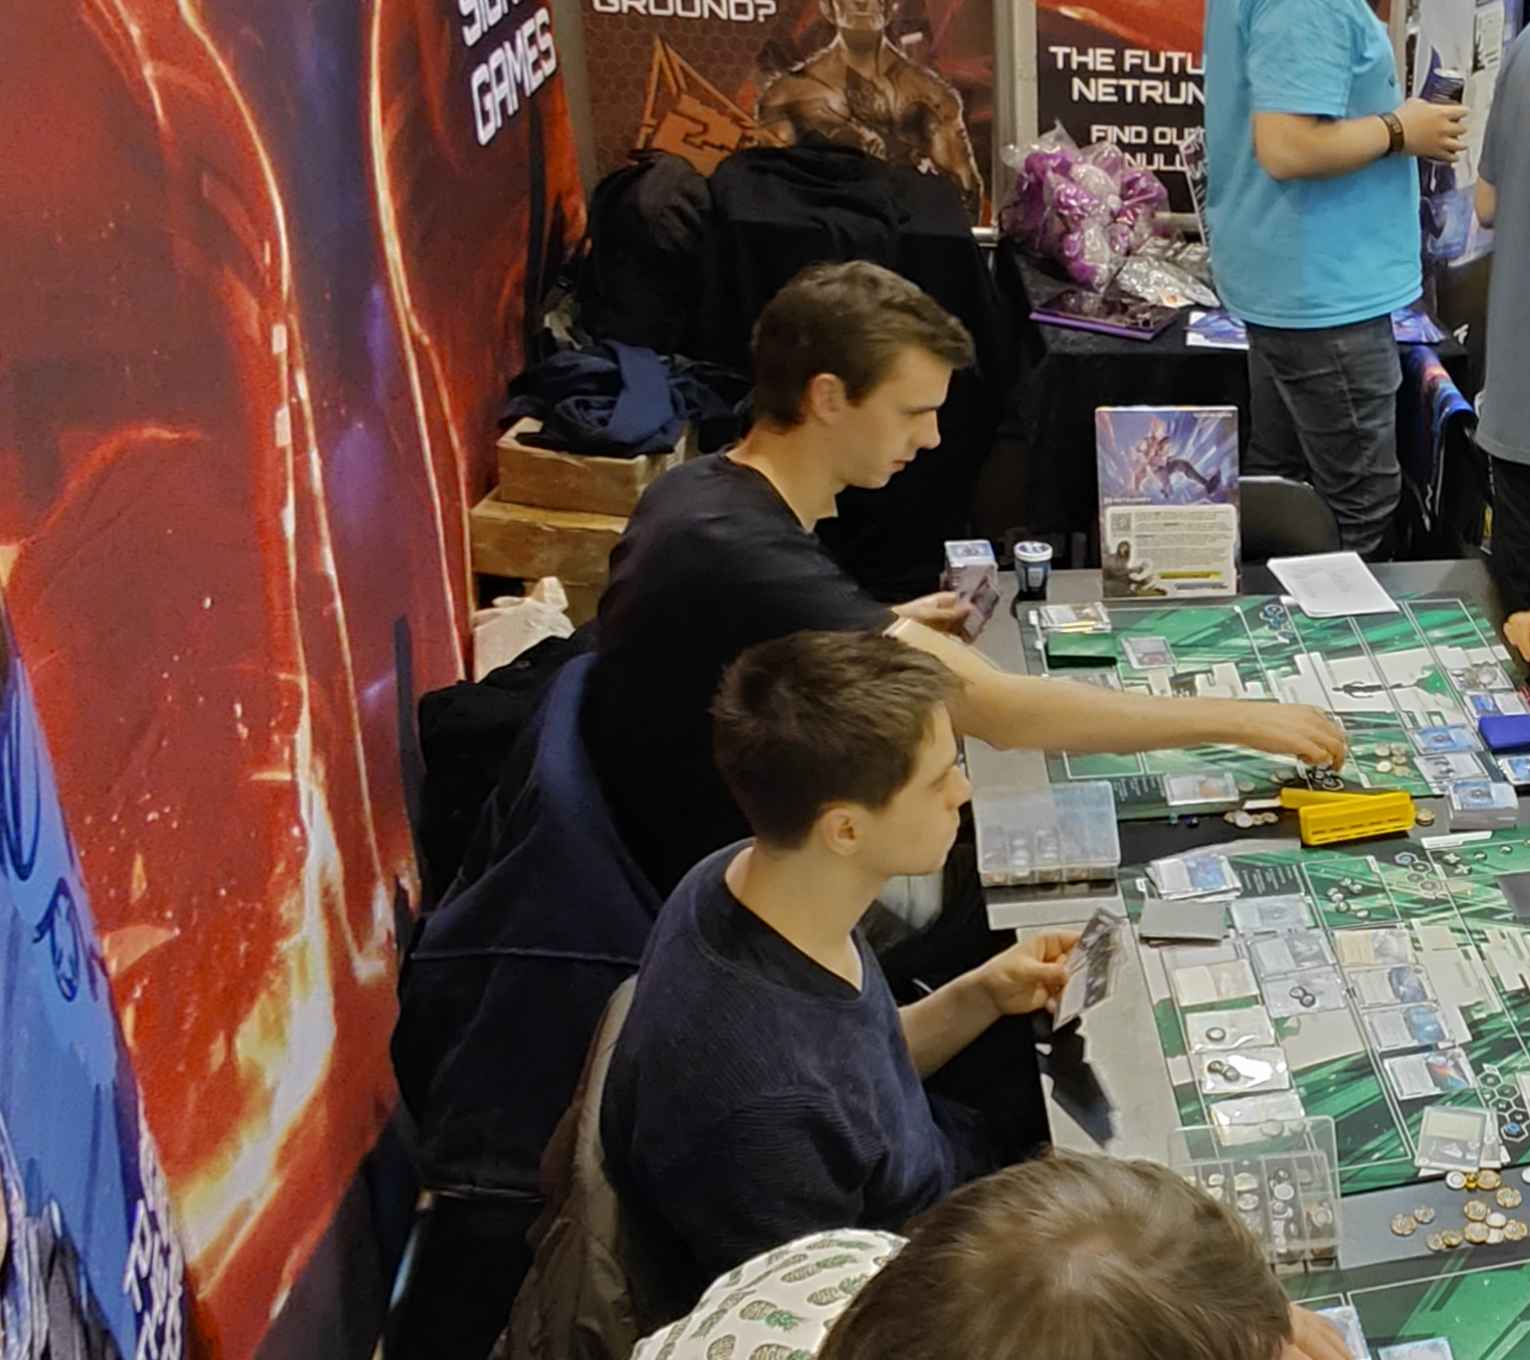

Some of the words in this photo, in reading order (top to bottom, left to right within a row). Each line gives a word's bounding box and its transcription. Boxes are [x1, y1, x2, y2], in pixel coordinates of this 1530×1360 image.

[1048, 46, 1116, 72] THE
[472, 6, 559, 147] GAMES
[1090, 124, 1148, 144] FIND
